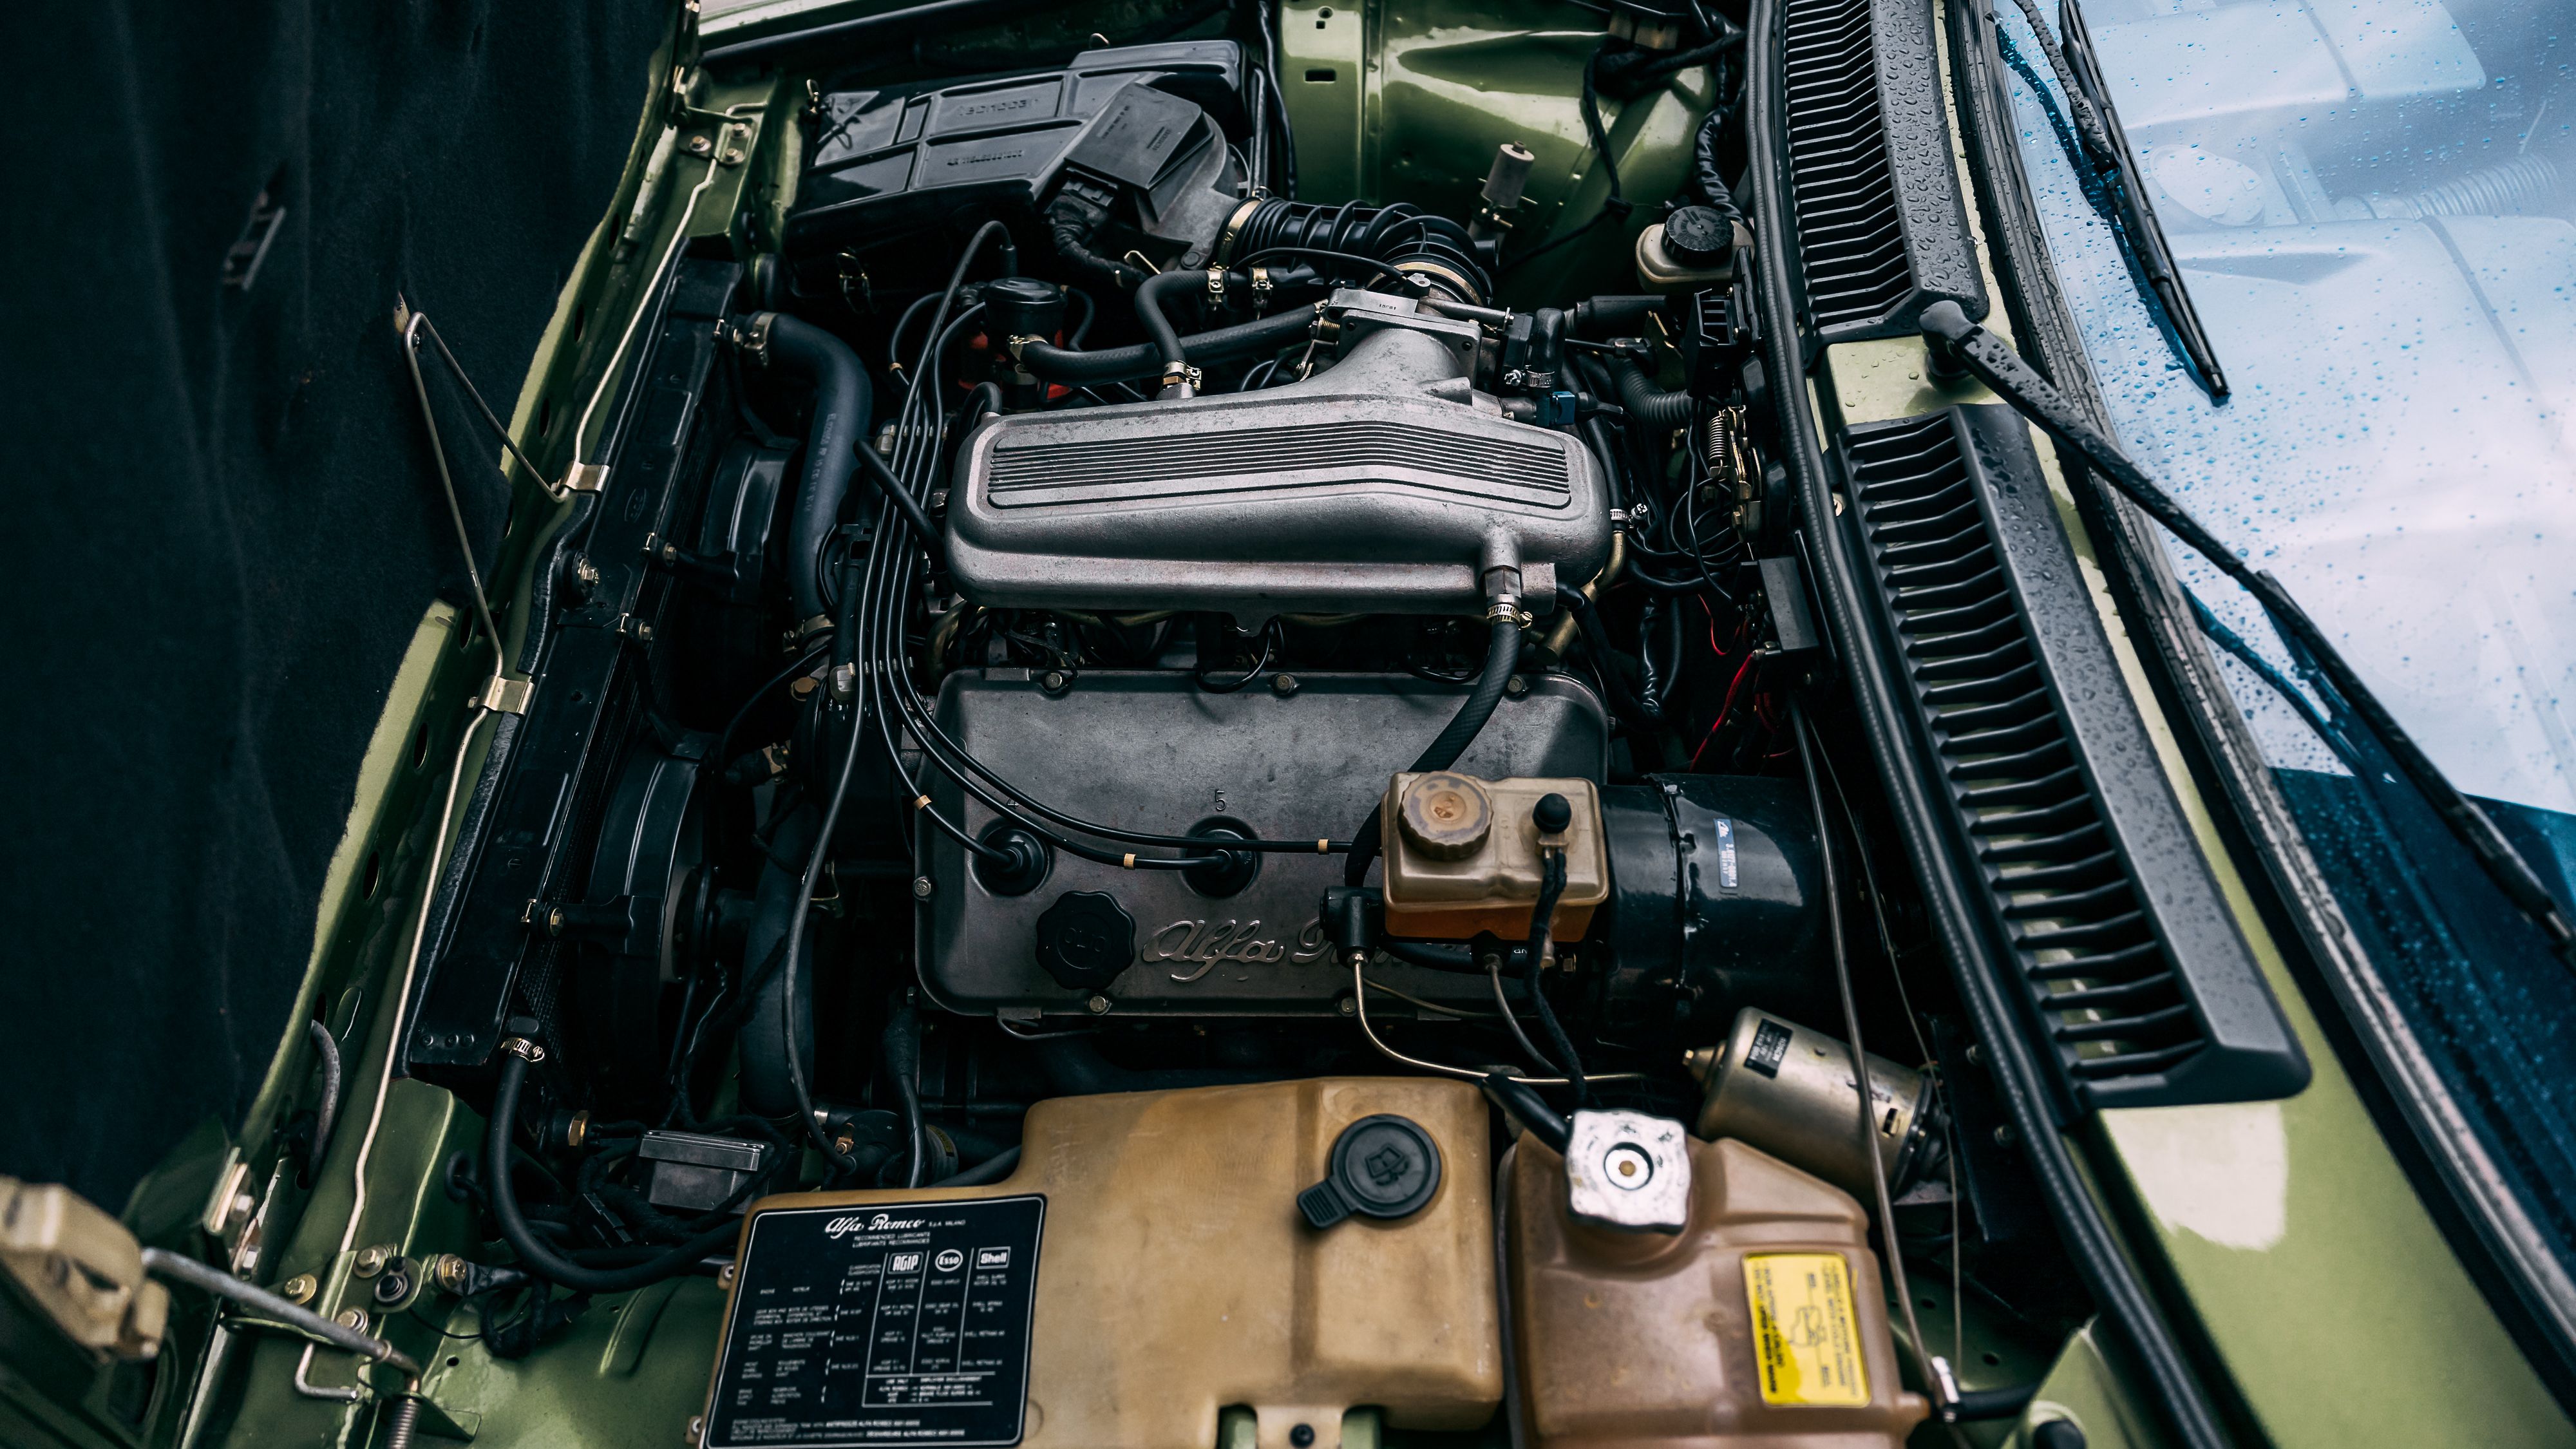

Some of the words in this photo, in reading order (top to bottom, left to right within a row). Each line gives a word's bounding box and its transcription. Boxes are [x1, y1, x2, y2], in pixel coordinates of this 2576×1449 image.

[1215, 789, 1226, 812] 5
[1142, 919, 1285, 983] Alfa
[824, 1217, 864, 1239] Alfa
[868, 1213, 925, 1231] Romeo
[893, 1255, 919, 1271] AGIP
[939, 1256, 960, 1265] Esso
[980, 1252, 1007, 1264] Shell
